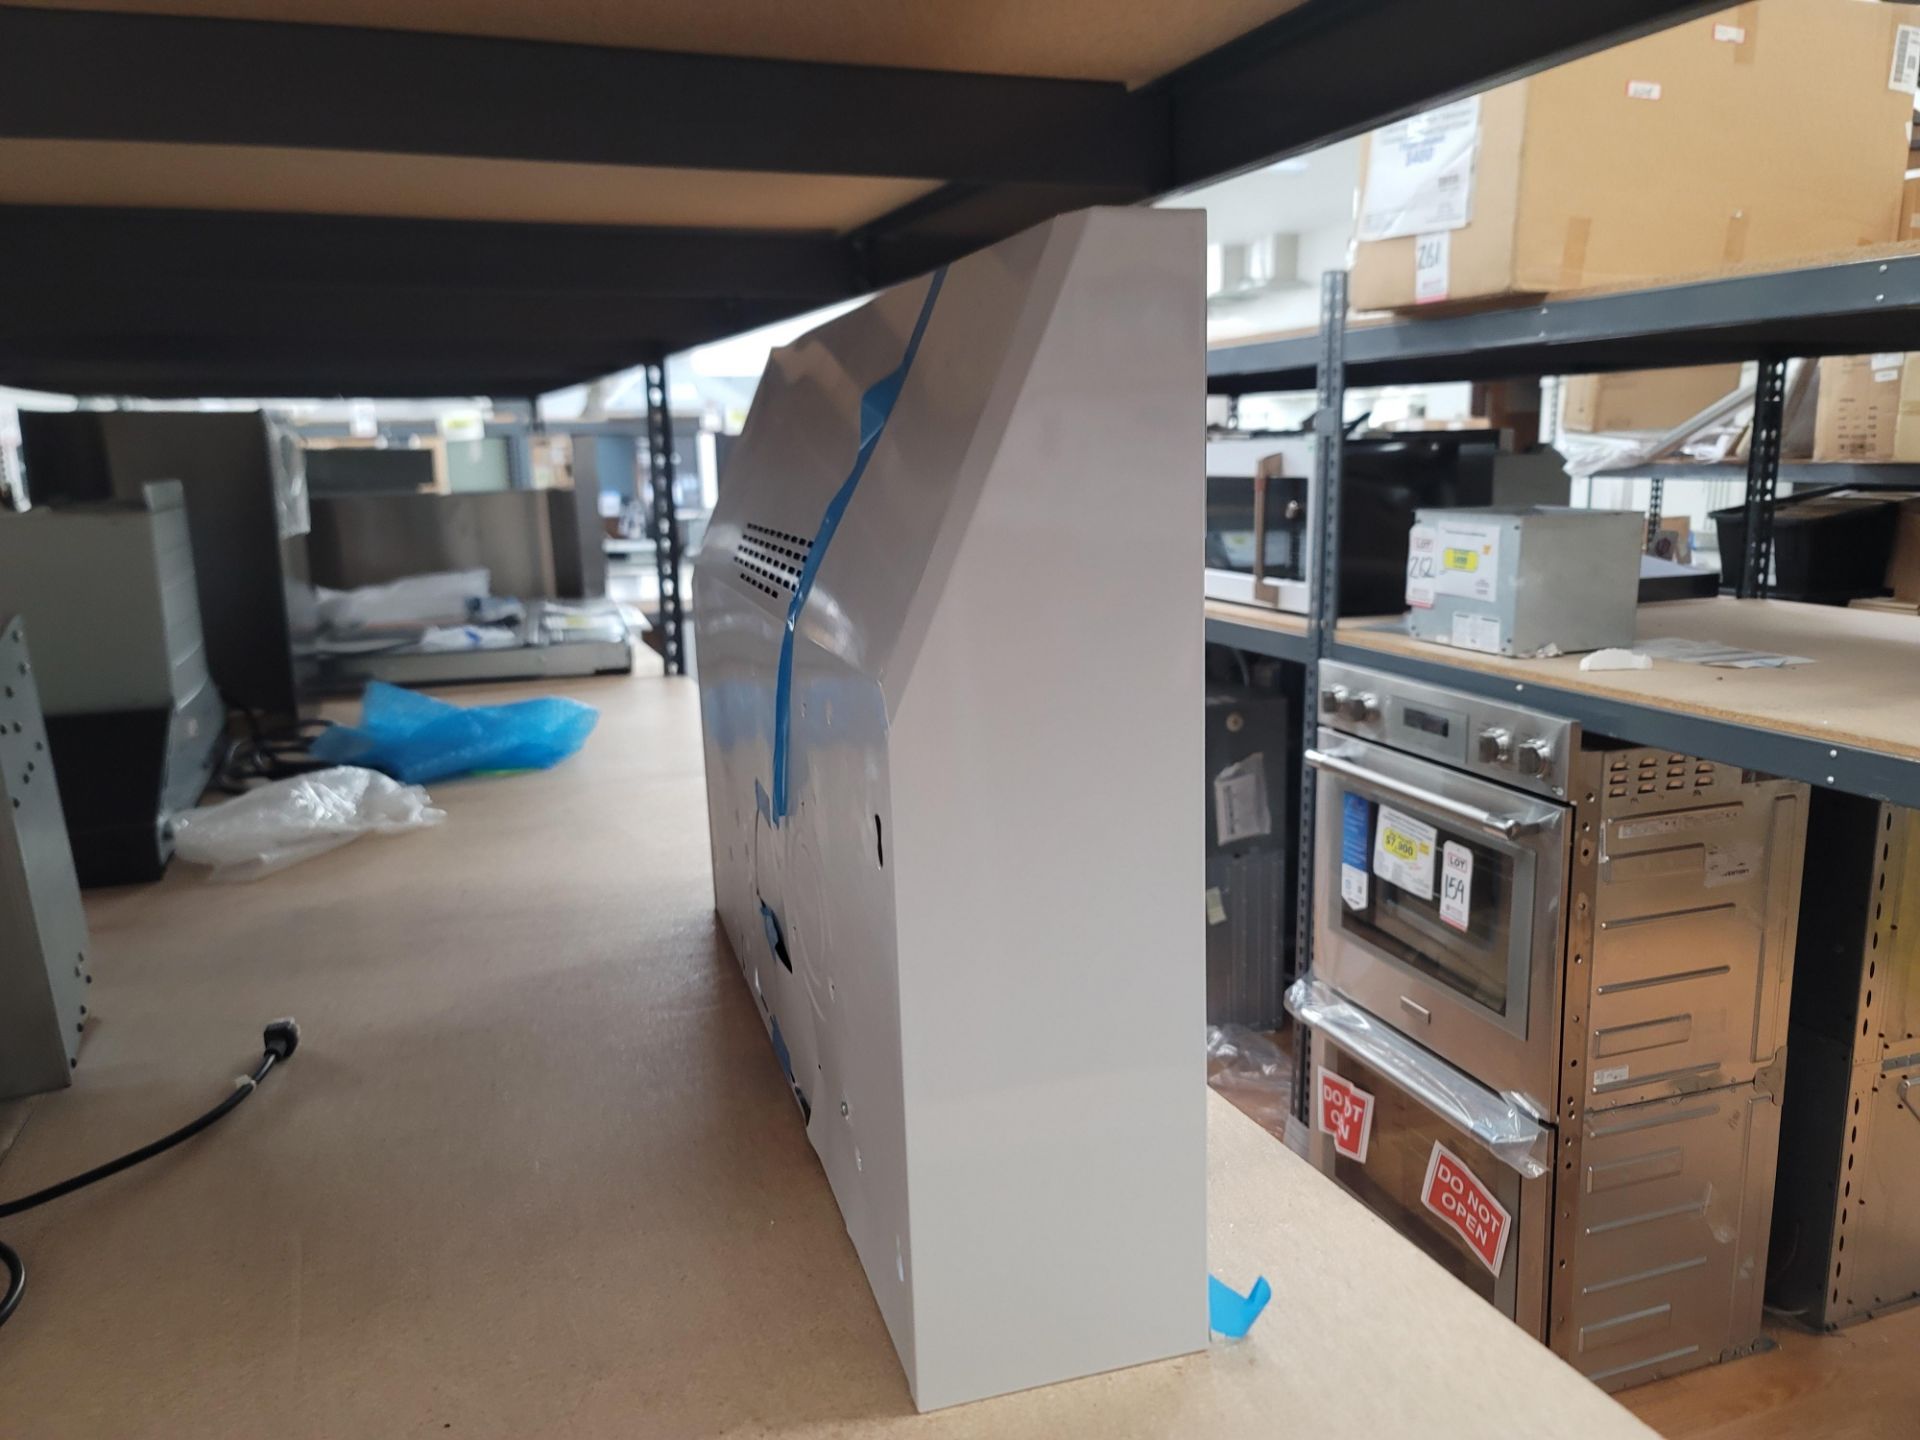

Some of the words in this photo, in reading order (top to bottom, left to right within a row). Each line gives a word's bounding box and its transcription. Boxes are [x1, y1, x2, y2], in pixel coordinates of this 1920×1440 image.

[1418, 241, 1441, 270] 261
[1444, 874, 1465, 905] 159
[1437, 1163, 1464, 1195] DO
[1467, 1190, 1500, 1234] NOT
[1441, 1191, 1488, 1247] OPEN
